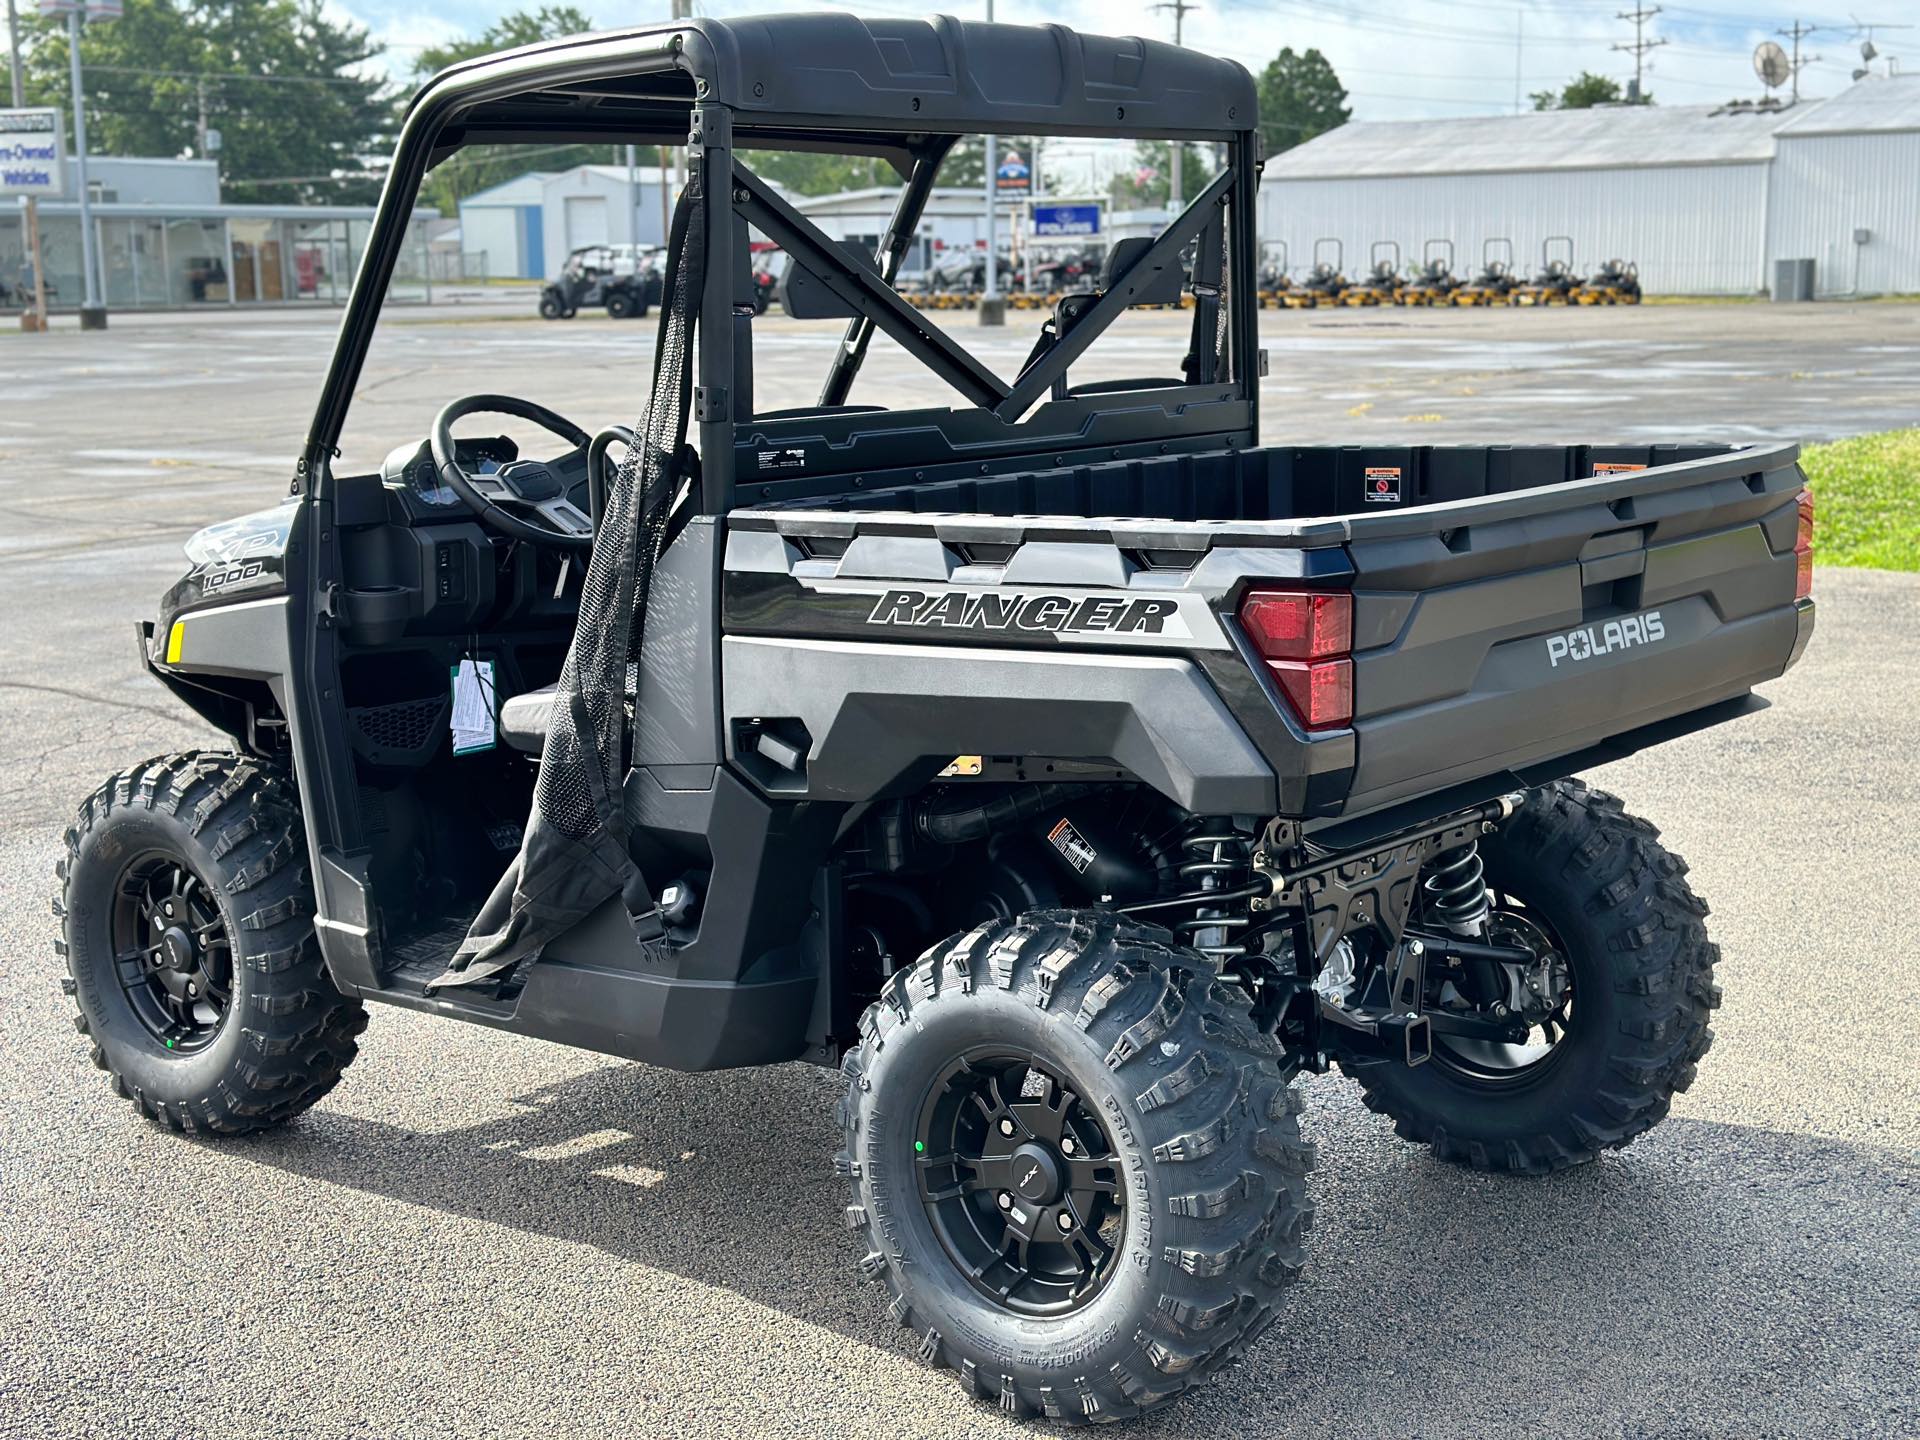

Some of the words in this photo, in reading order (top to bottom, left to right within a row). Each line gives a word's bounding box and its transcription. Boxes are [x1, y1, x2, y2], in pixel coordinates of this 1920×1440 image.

[1038, 222, 1093, 235] POLARIS
[188, 529, 280, 578] XP
[202, 561, 263, 592] 1000
[866, 589, 1179, 634] RANGER
[1546, 611, 1665, 668] POLARIS
[1019, 1164, 1038, 1188] XP
[1103, 1094, 1135, 1147] PRO
[1127, 1152, 1152, 1248] ARMOR
